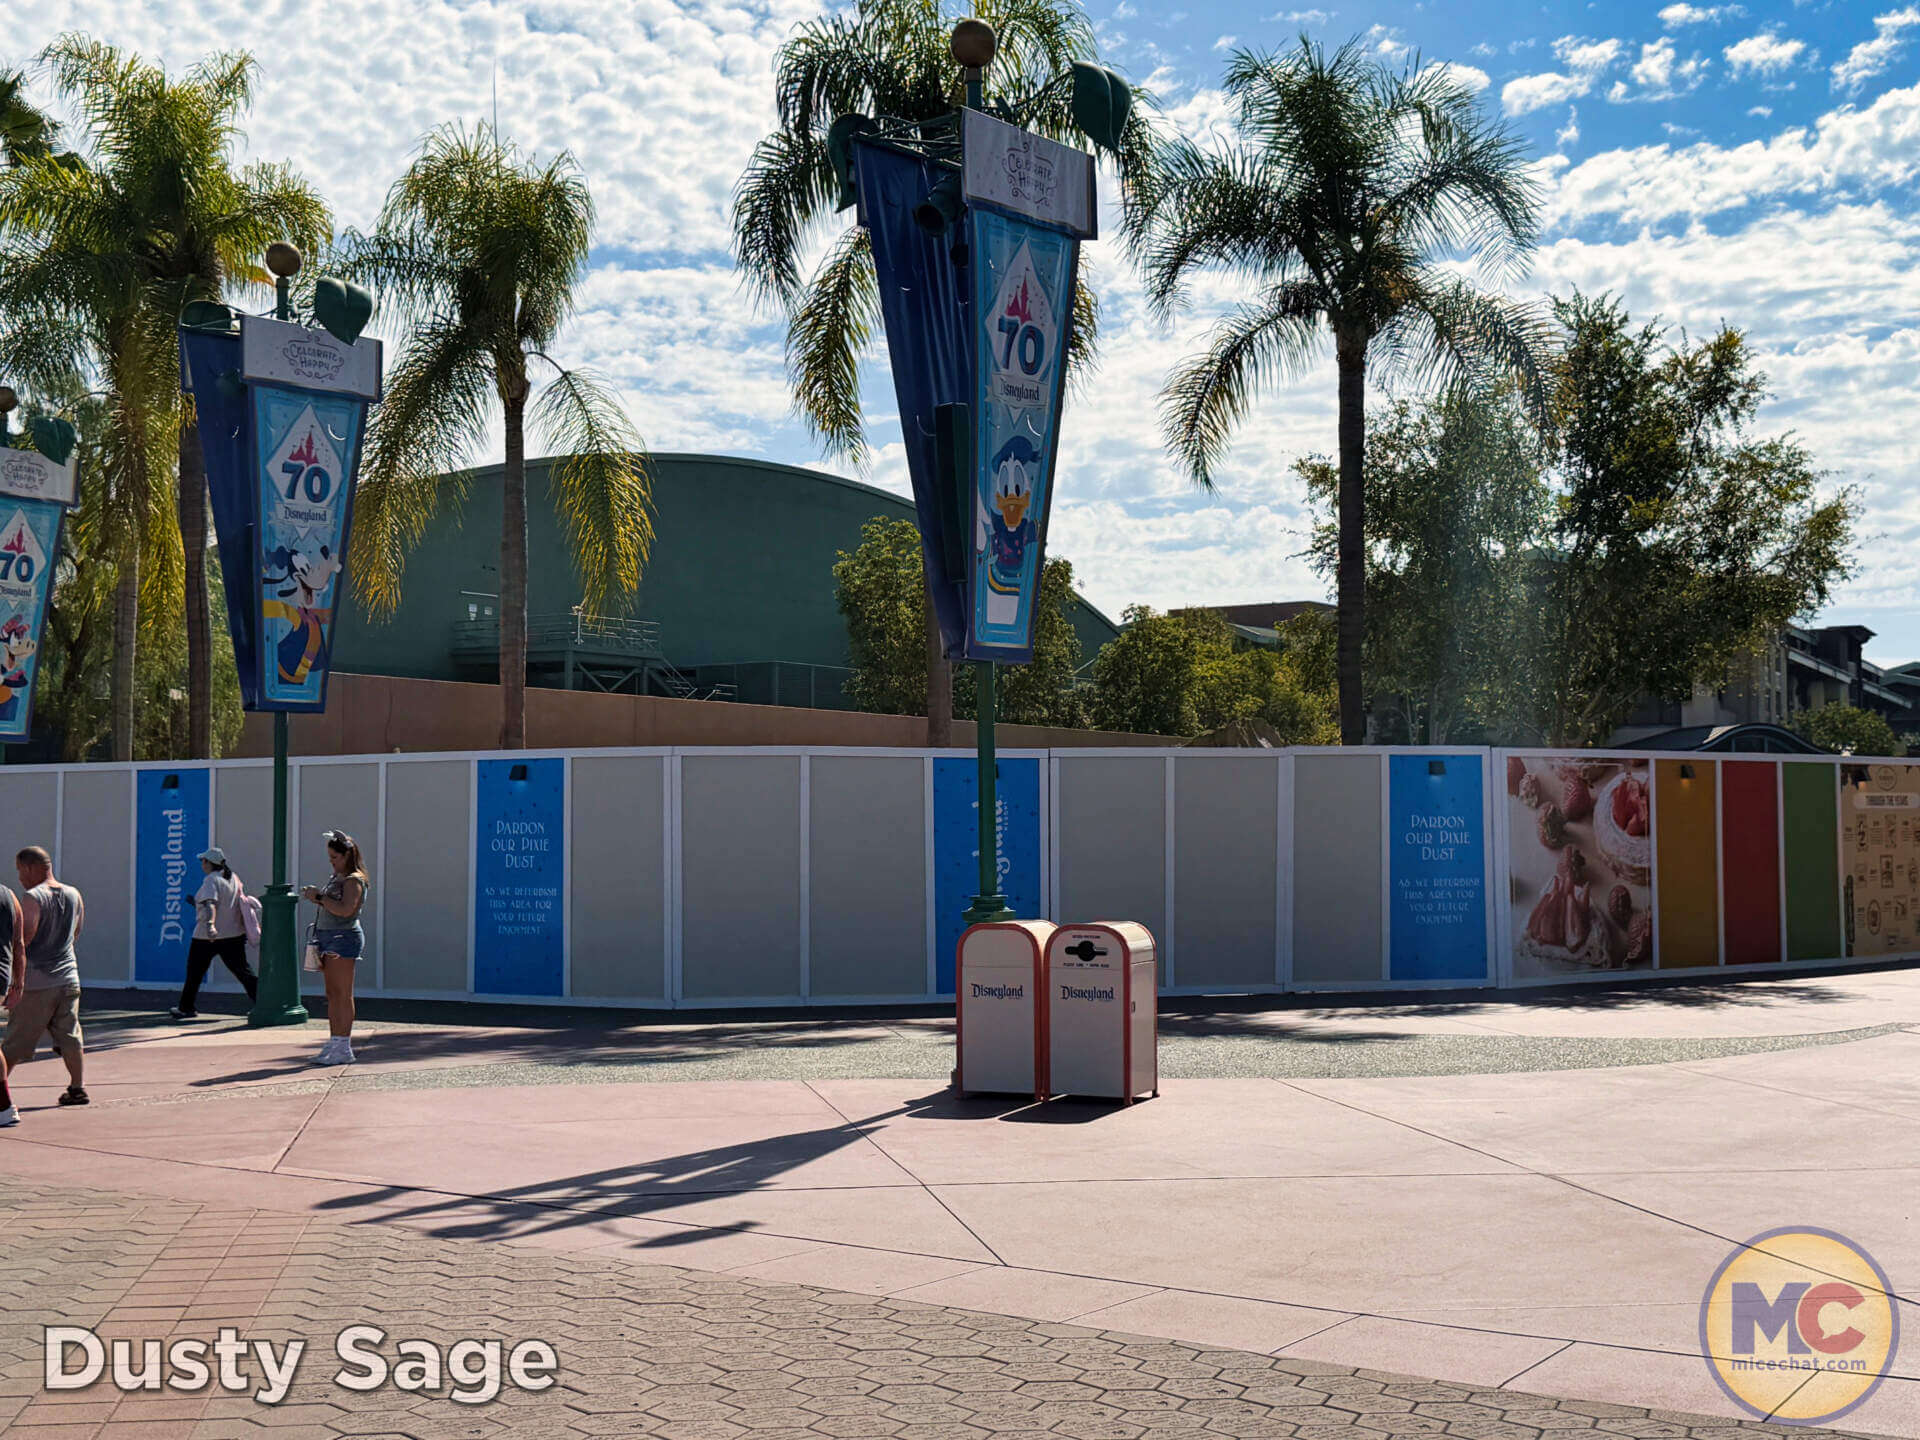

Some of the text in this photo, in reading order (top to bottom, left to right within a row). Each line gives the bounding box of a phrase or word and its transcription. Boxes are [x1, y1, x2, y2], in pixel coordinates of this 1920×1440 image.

[998, 315, 1045, 376] 70
[1000, 377, 1040, 401] Disneyland
[282, 461, 331, 503] 70
[284, 506, 327, 522] Disneyland
[0, 551, 35, 582] 70
[496, 820, 545, 835] PARDON
[1411, 814, 1465, 829] PARDON
[491, 837, 550, 852] OUR PIXIE
[1405, 832, 1433, 845] OUR
[505, 853, 535, 869] DUST
[1422, 846, 1455, 861] DUST
[159, 808, 187, 946] Disneyland
[971, 983, 1024, 1000] Disneyland
[1060, 986, 1114, 1001] Disneyland
